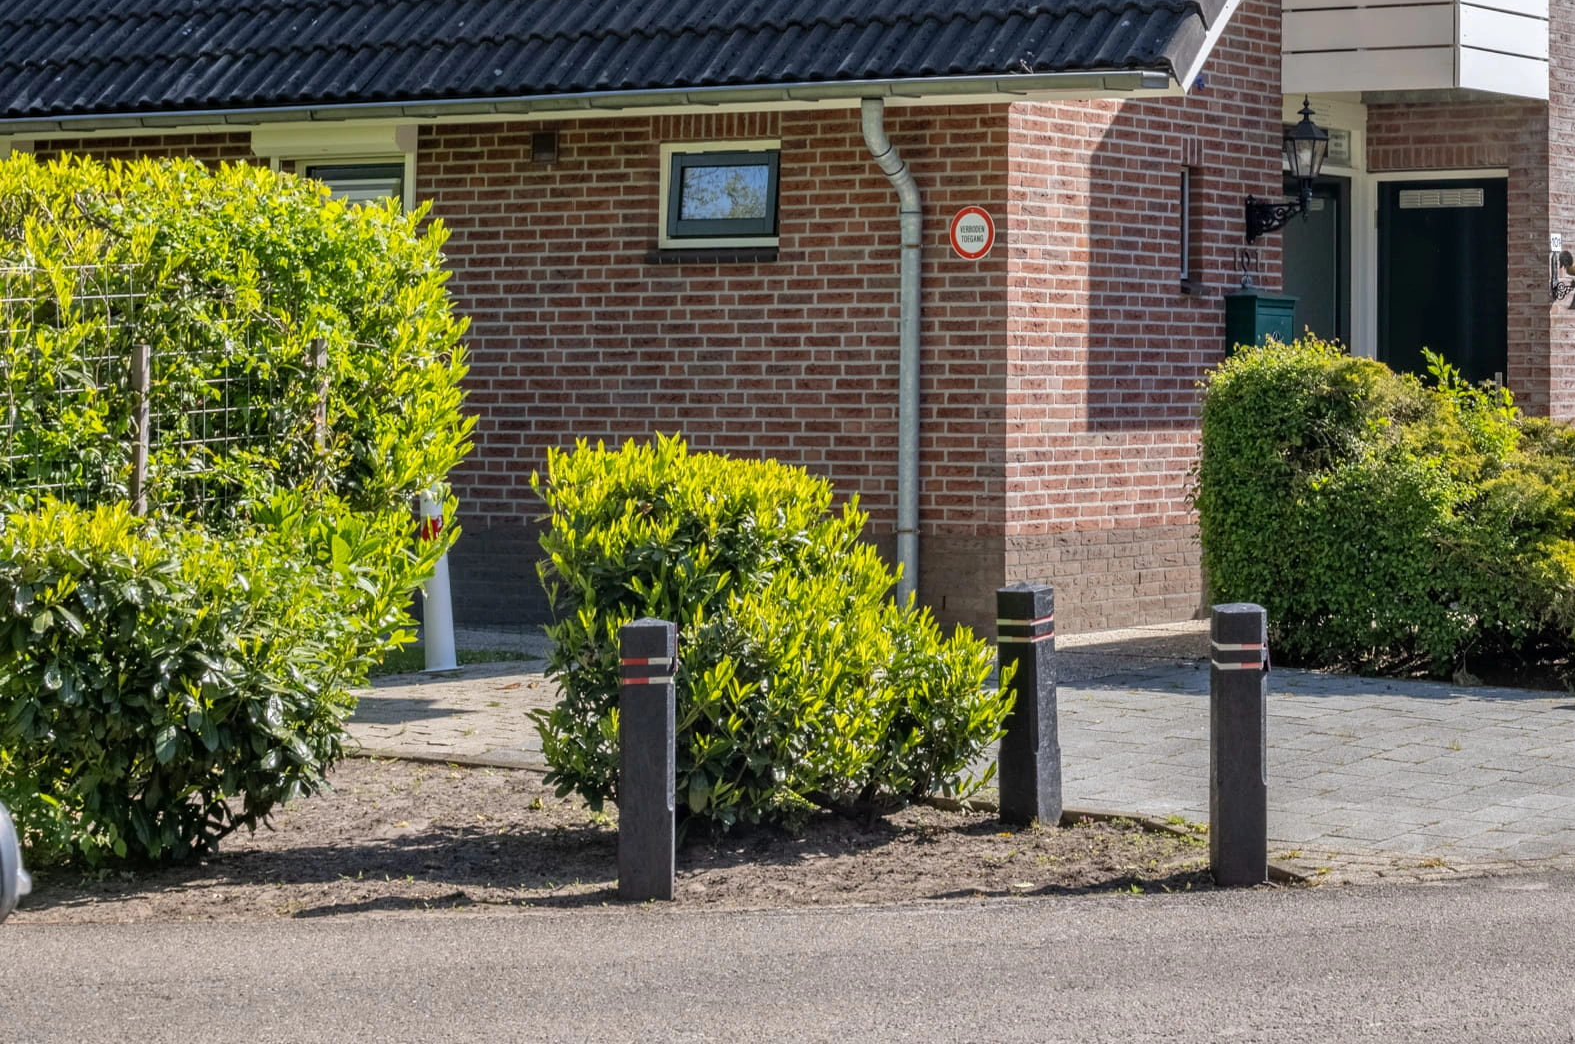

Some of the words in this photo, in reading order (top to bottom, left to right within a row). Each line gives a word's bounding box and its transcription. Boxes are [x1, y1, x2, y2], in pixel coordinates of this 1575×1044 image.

[960, 225, 984, 234] VERBODEN
[961, 235, 984, 243] TOEGANG
[1551, 237, 1561, 247] 101
[1233, 247, 1259, 272] 101
